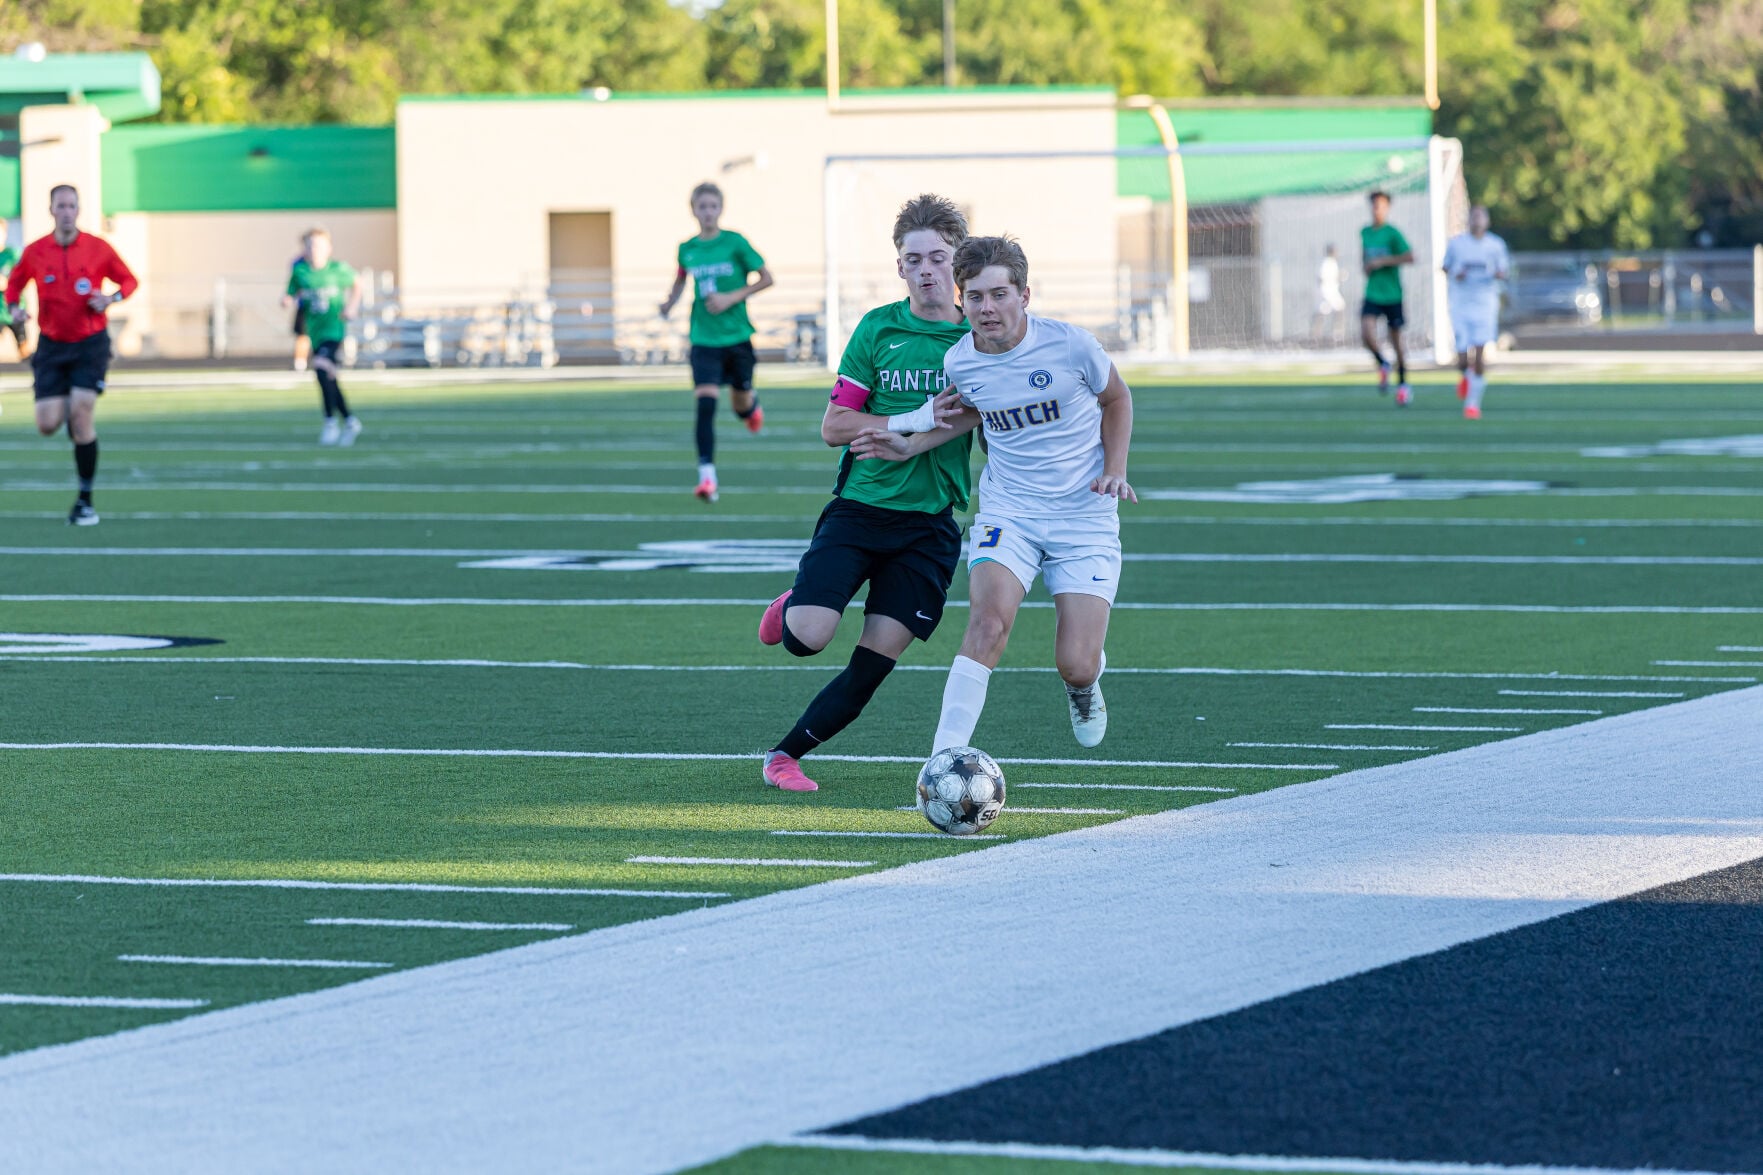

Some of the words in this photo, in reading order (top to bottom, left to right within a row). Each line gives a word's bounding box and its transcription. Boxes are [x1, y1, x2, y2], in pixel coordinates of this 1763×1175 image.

[879, 369, 947, 392] PANTH
[981, 399, 1060, 432] HUTCH
[977, 525, 1003, 549] 3
